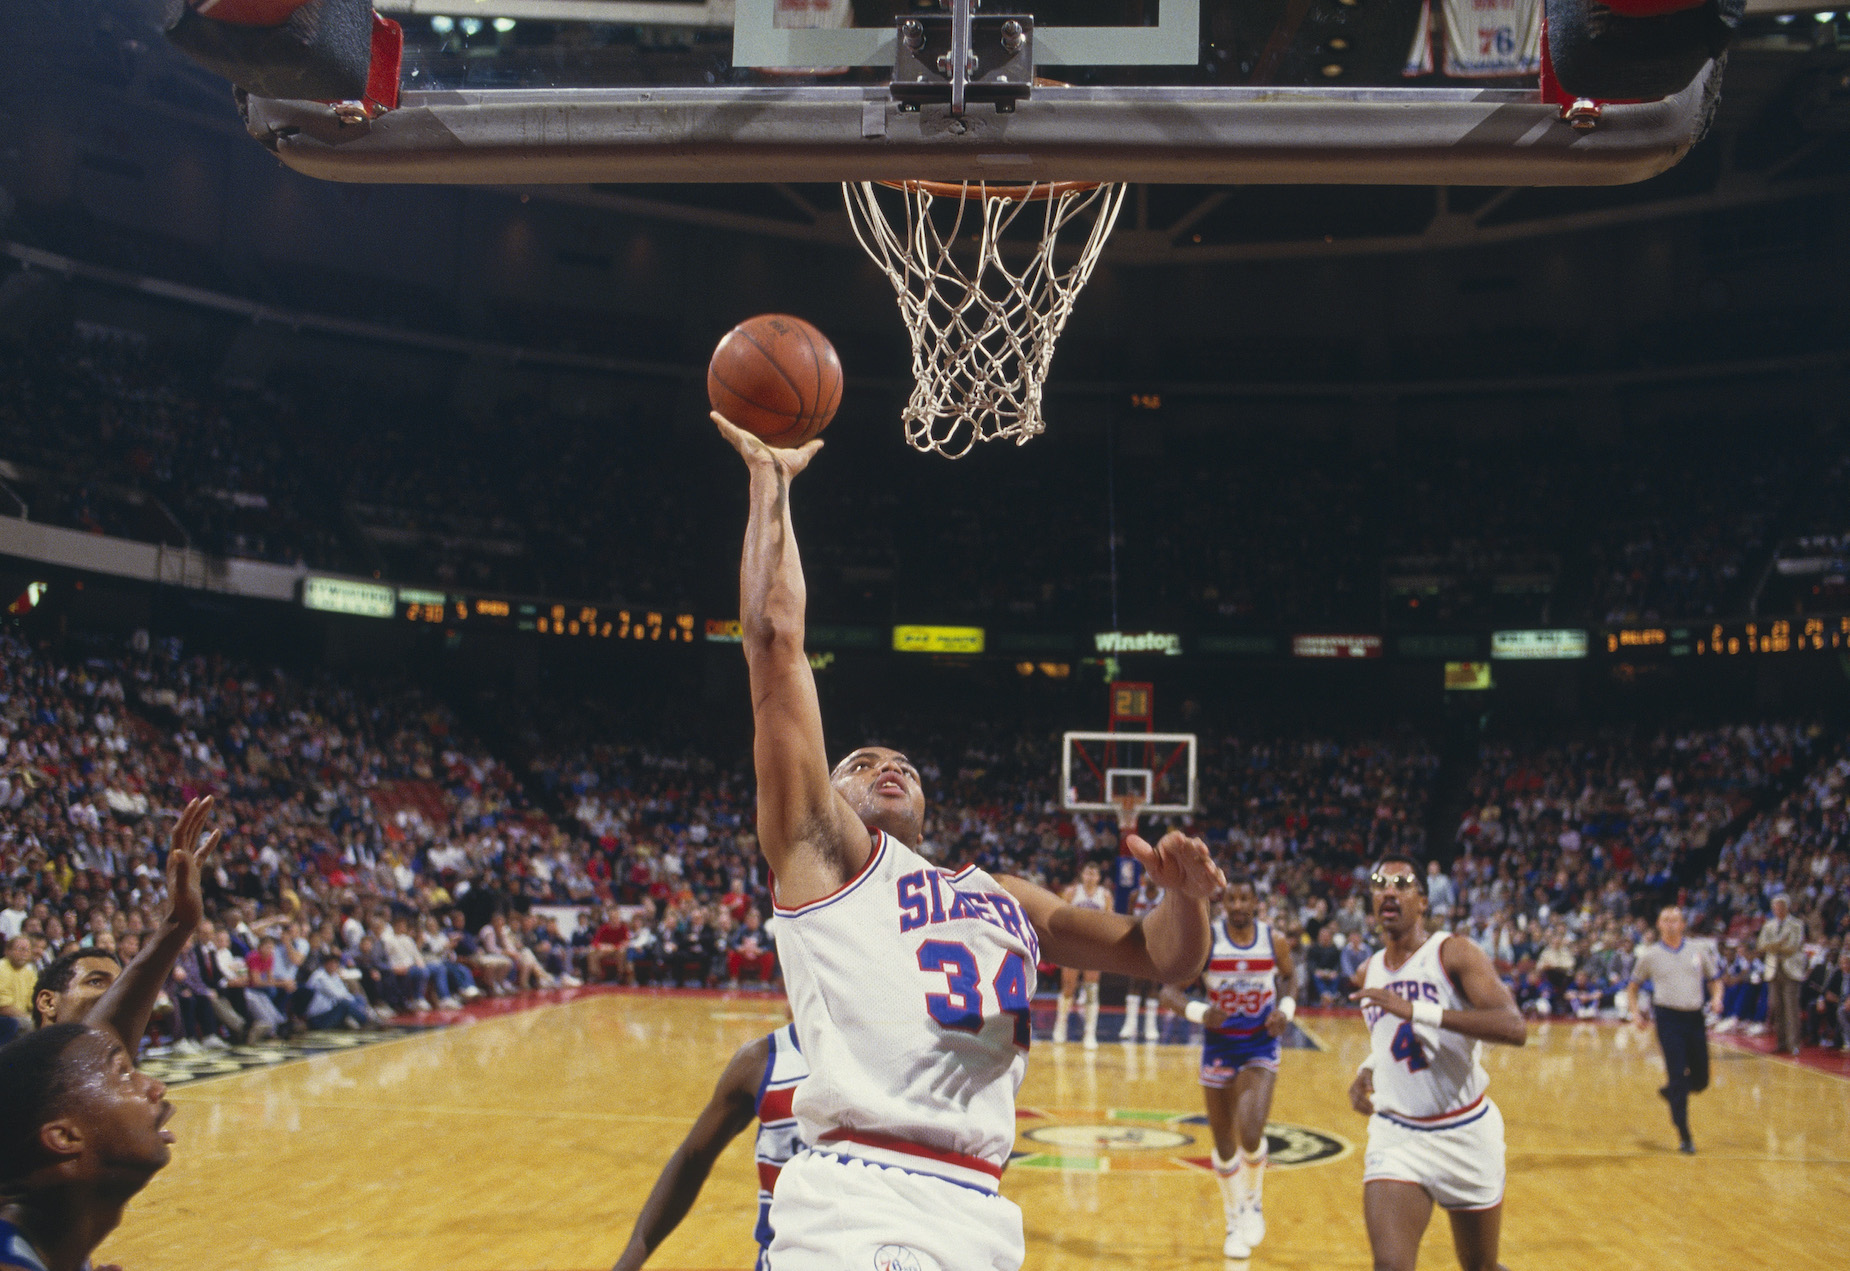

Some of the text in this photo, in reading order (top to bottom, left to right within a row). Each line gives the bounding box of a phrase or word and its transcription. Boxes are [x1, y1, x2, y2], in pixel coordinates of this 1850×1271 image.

[1478, 26, 1515, 56] 76
[1116, 689, 1147, 715] 21
[916, 938, 1031, 1051] 34
[1221, 990, 1261, 1014] 23
[1391, 1020, 1429, 1074] 4
